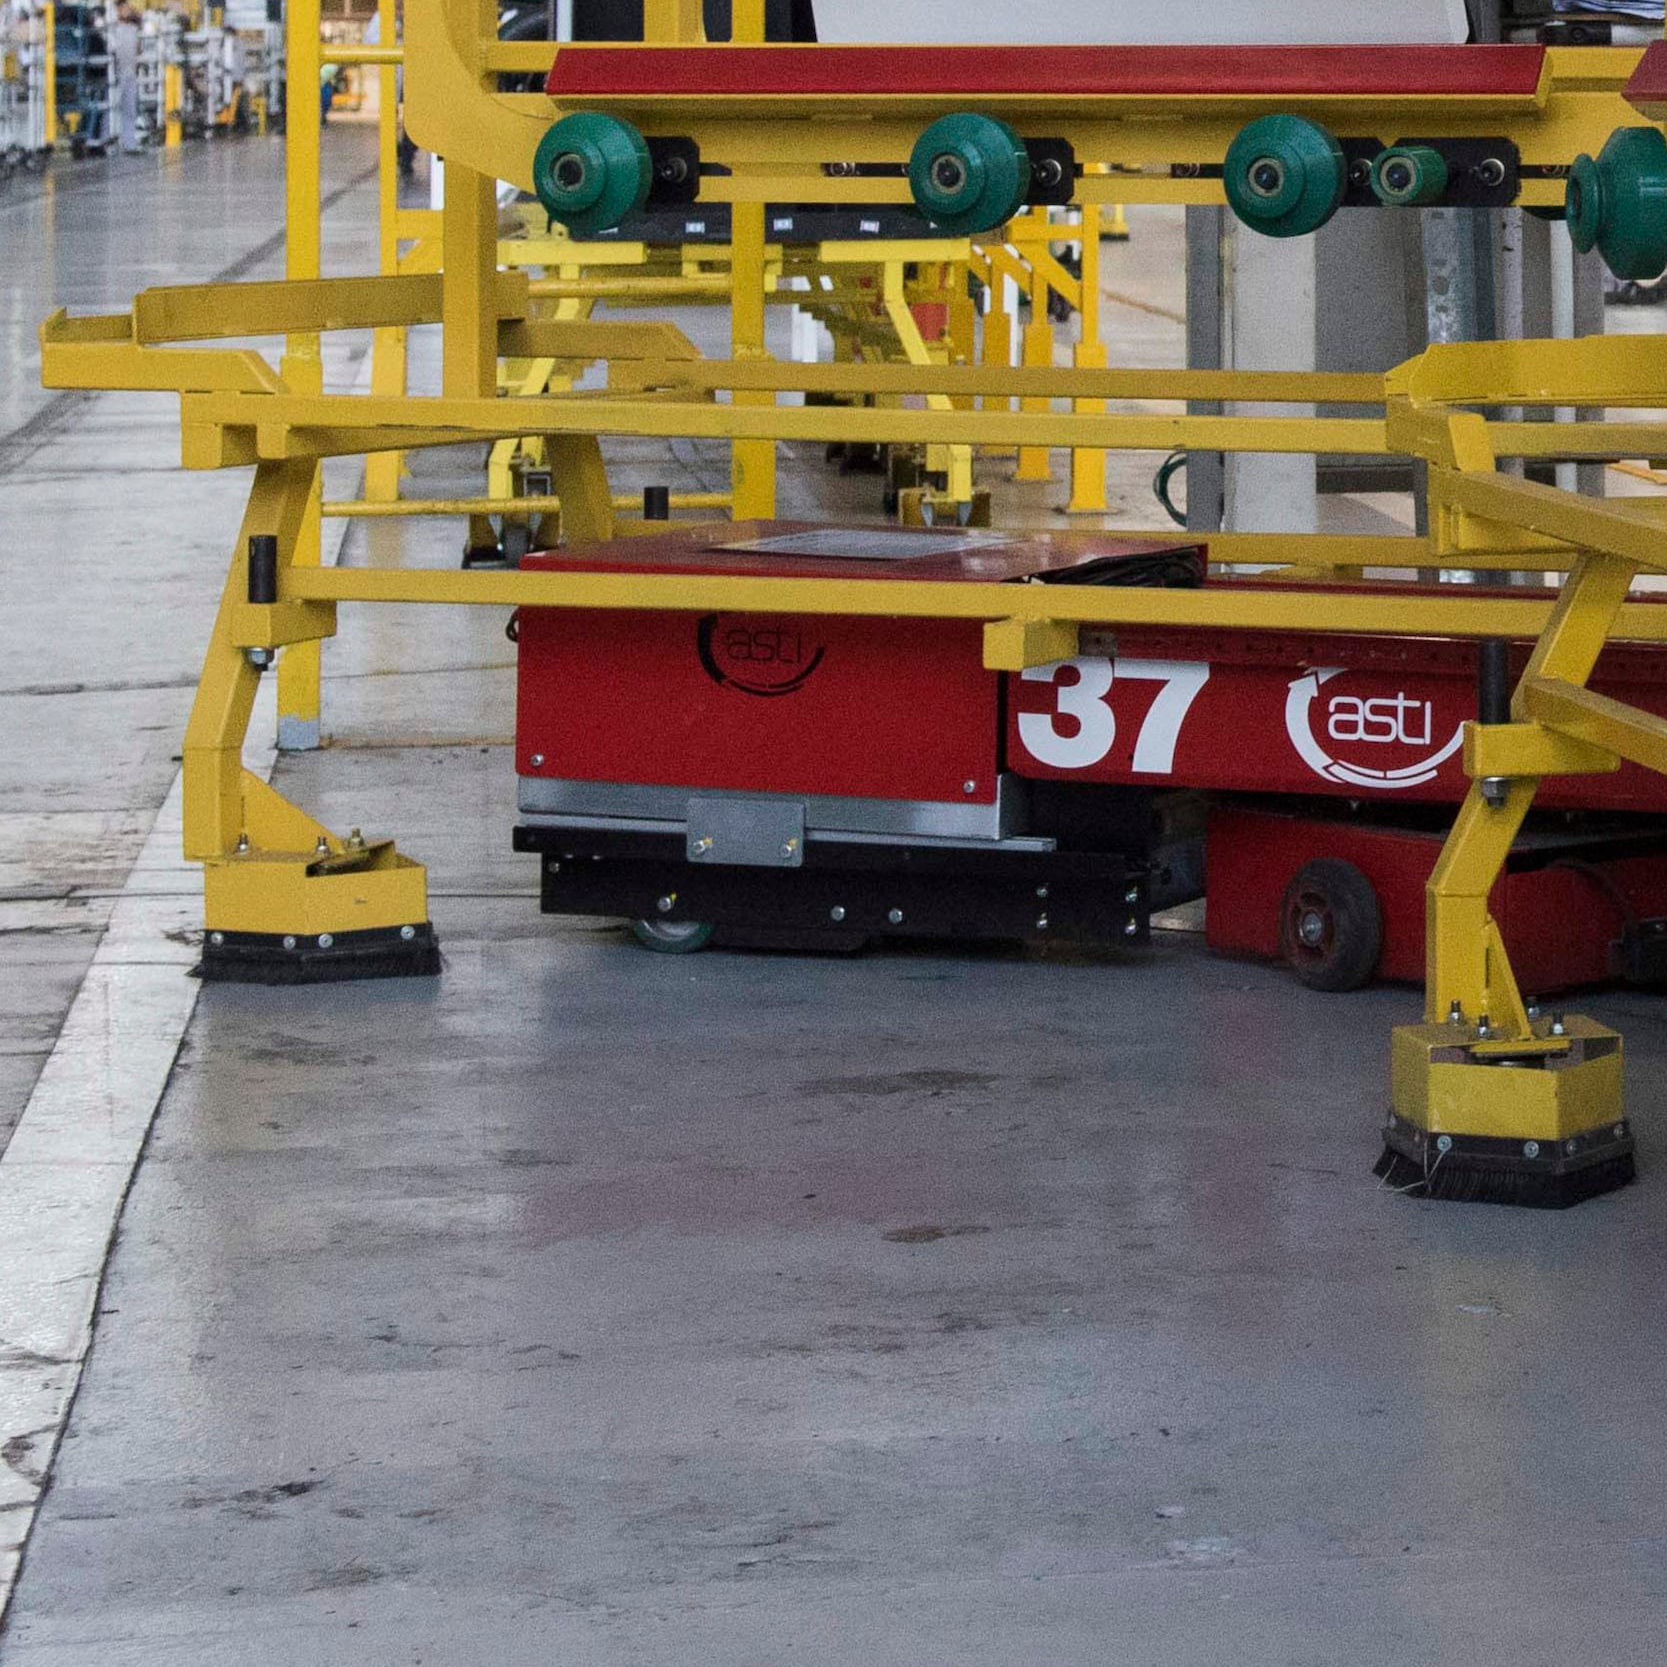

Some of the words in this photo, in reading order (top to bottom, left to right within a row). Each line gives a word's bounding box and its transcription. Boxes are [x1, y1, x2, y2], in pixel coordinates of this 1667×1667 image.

[726, 620, 801, 664] asti
[1017, 654, 1210, 775] 37
[1328, 691, 1431, 746] asti
